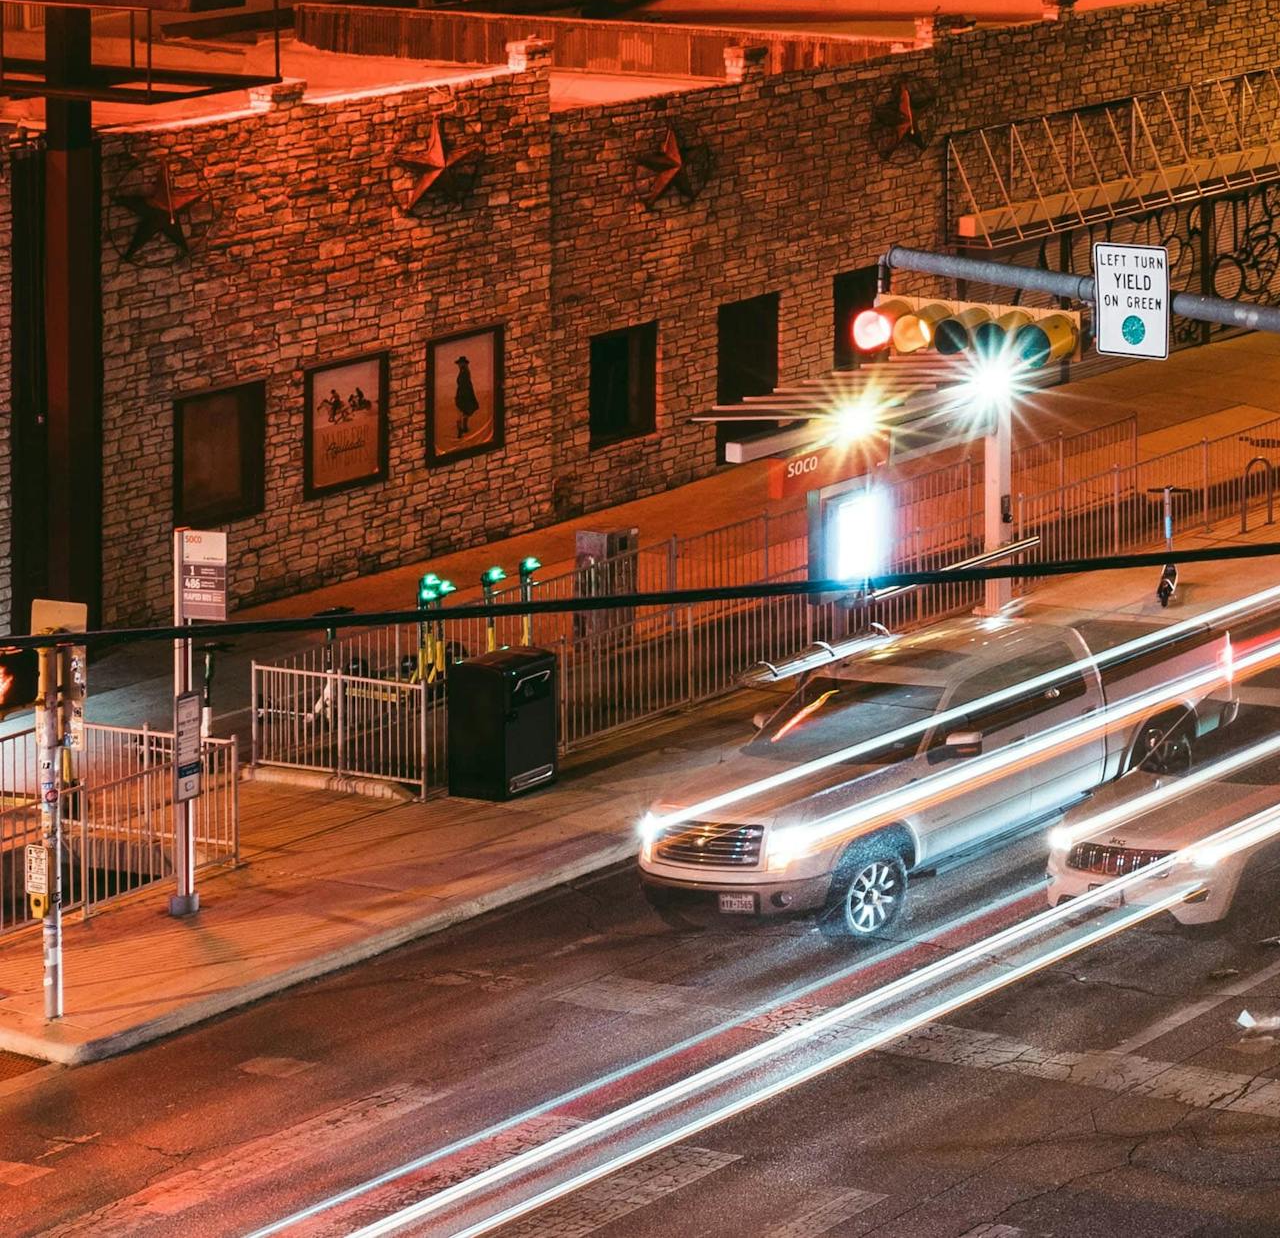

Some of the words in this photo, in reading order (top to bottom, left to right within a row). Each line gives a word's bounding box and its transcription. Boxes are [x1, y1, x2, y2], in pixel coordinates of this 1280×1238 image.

[1100, 253, 1127, 267] LEFT
[1134, 255, 1163, 270] TURN
[1114, 273, 1152, 291] YIELD
[1104, 294, 1119, 307] ON
[1126, 296, 1162, 310] GREEN
[787, 456, 818, 478] SOCO
[185, 535, 202, 544] SOCO
[189, 565, 195, 576] 1
[184, 578, 201, 589] 486
